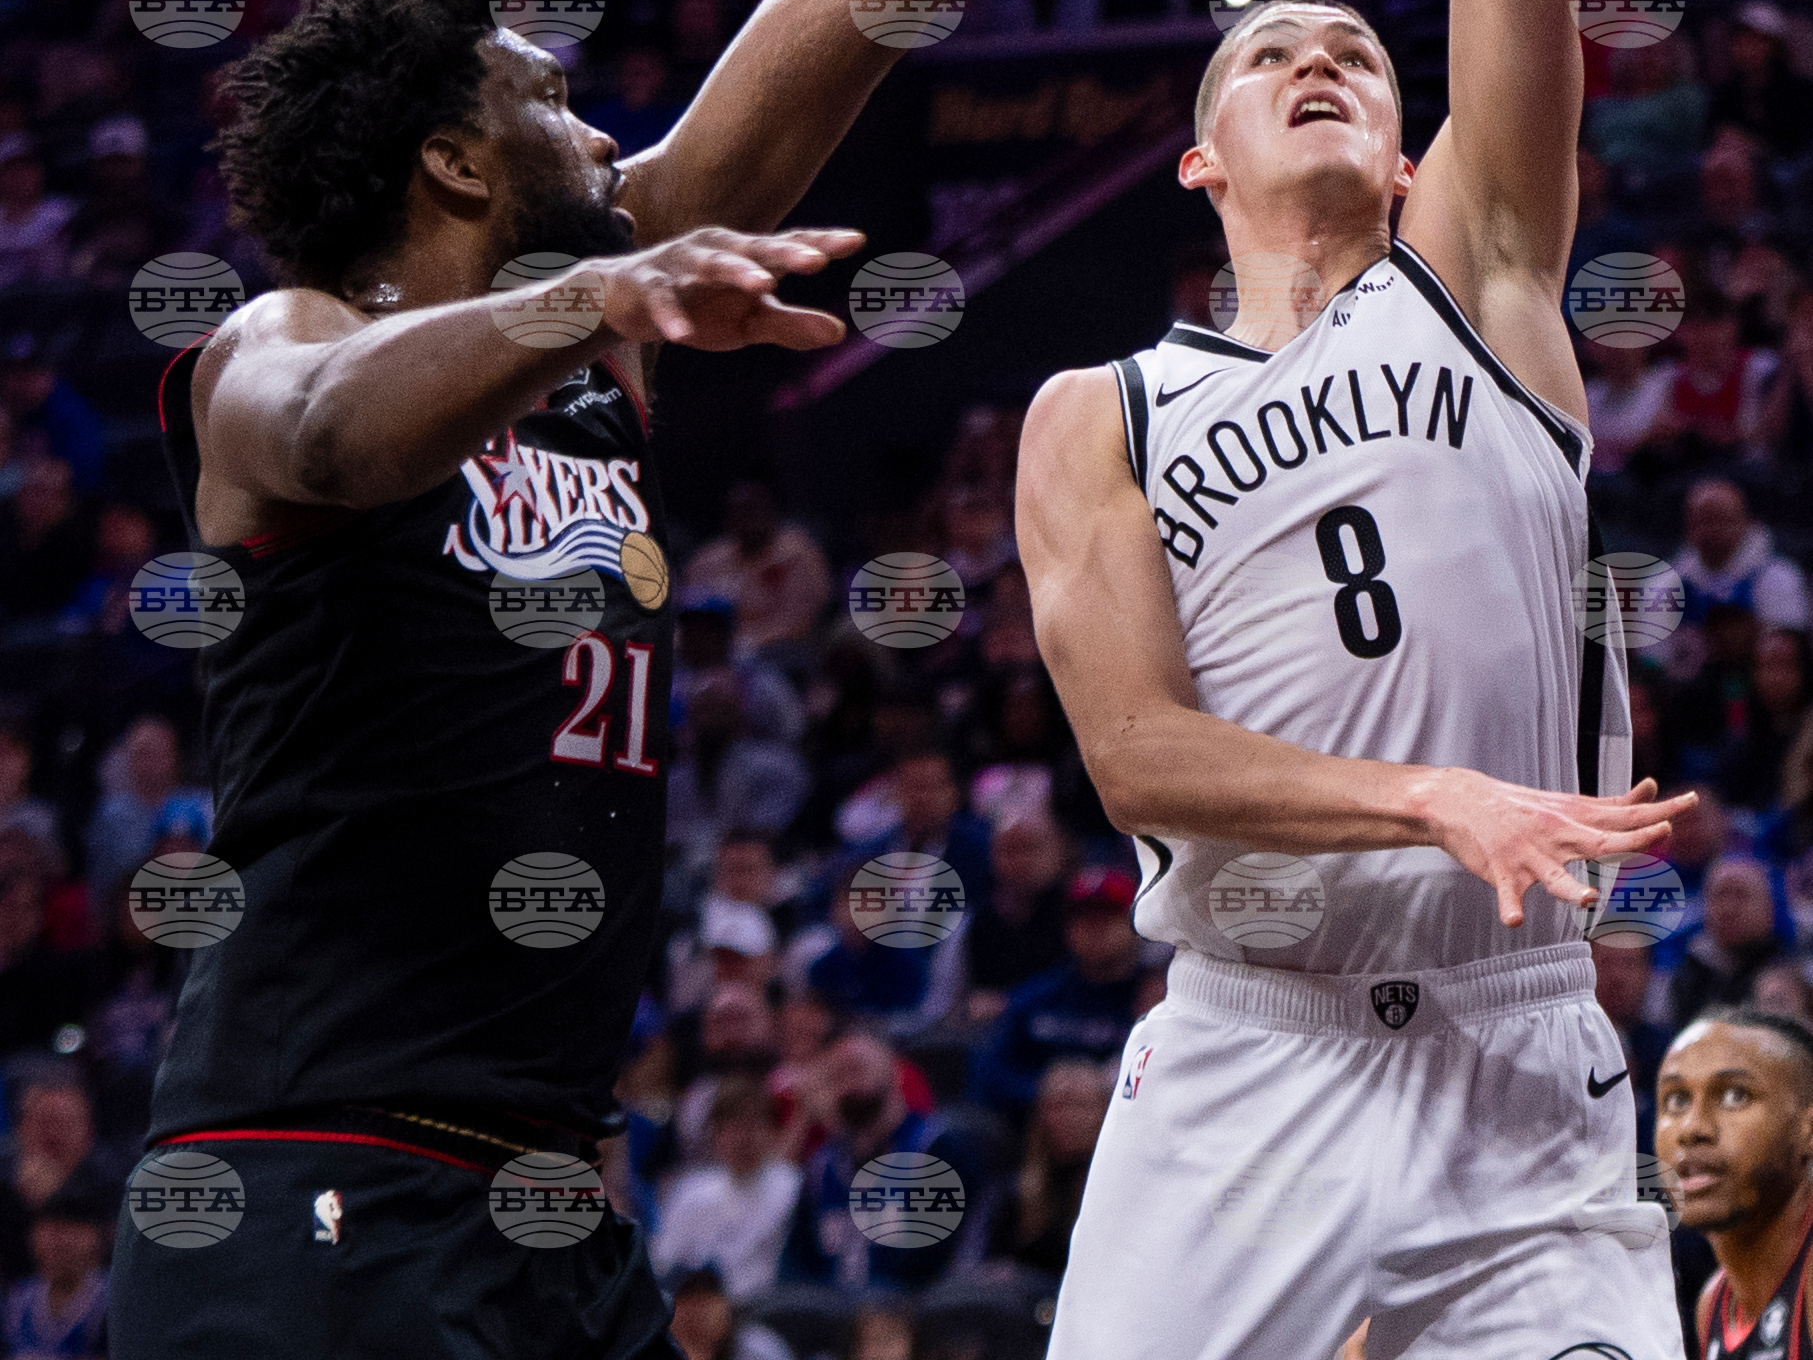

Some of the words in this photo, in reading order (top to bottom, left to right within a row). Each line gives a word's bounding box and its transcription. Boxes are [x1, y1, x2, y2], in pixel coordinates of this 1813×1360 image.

[1153, 361, 1474, 570] BROOKLYN
[1315, 504, 1403, 660] 8
[549, 631, 661, 778] 21
[1374, 984, 1417, 1007] NETS
